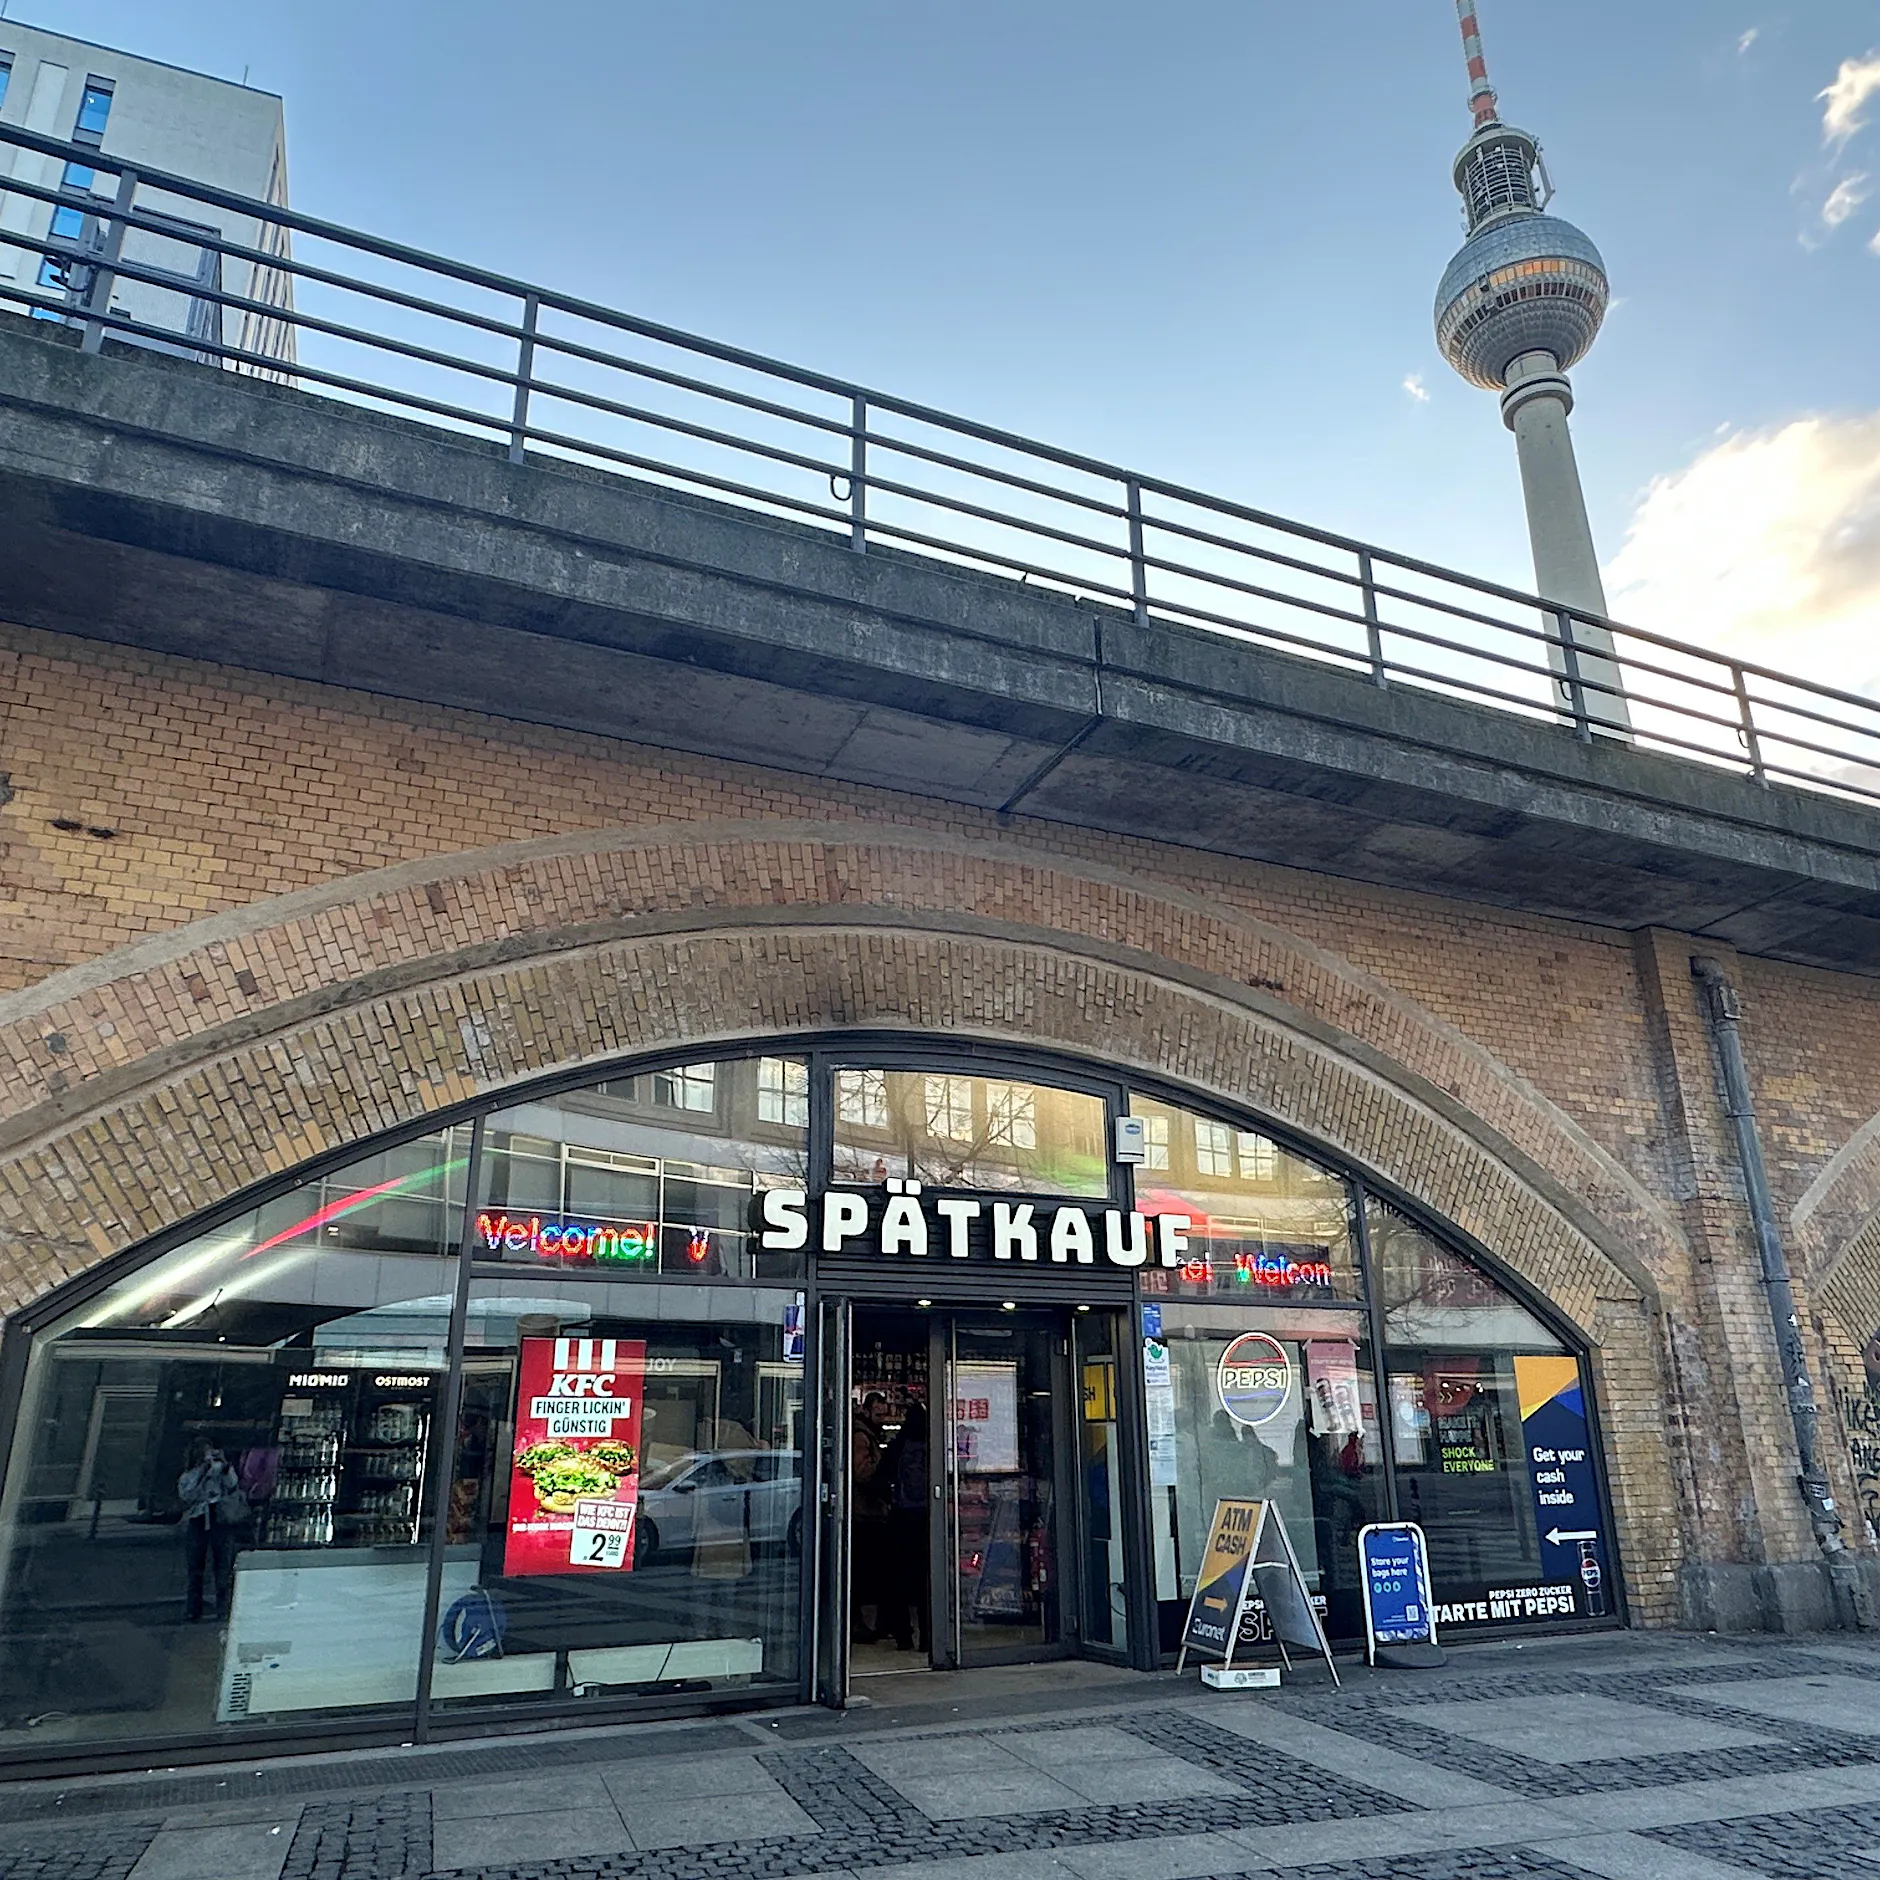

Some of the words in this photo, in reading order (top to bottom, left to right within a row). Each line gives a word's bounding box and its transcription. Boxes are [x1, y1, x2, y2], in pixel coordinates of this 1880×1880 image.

[762, 1178, 1191, 1267] SPÄTKAUF
[548, 1373, 616, 1398] KFC
[1223, 1368, 1287, 1389] PEPSI
[536, 1401, 579, 1414] FINGER
[583, 1401, 626, 1414] LICKIN'
[553, 1417, 606, 1433] GÜNSTIG
[1441, 1447, 1476, 1459] SHOCK
[1533, 1447, 1556, 1462] Get
[1557, 1450, 1585, 1465] your
[1443, 1459, 1494, 1472] EVERYONE
[1537, 1468, 1565, 1483] cash
[1538, 1489, 1574, 1505] inside
[1221, 1507, 1253, 1532] ATM
[1216, 1533, 1247, 1555] CASH
[1392, 1557, 1409, 1567] your
[1489, 1590, 1514, 1600] PEPSI
[1515, 1588, 1537, 1598] ZERO
[1539, 1586, 1572, 1597] ZUCKER
[1242, 1600, 1264, 1610] EPSI
[1432, 1602, 1487, 1623] TARTE
[1490, 1599, 1521, 1618] MIT
[1525, 1596, 1576, 1616] PEPSI
